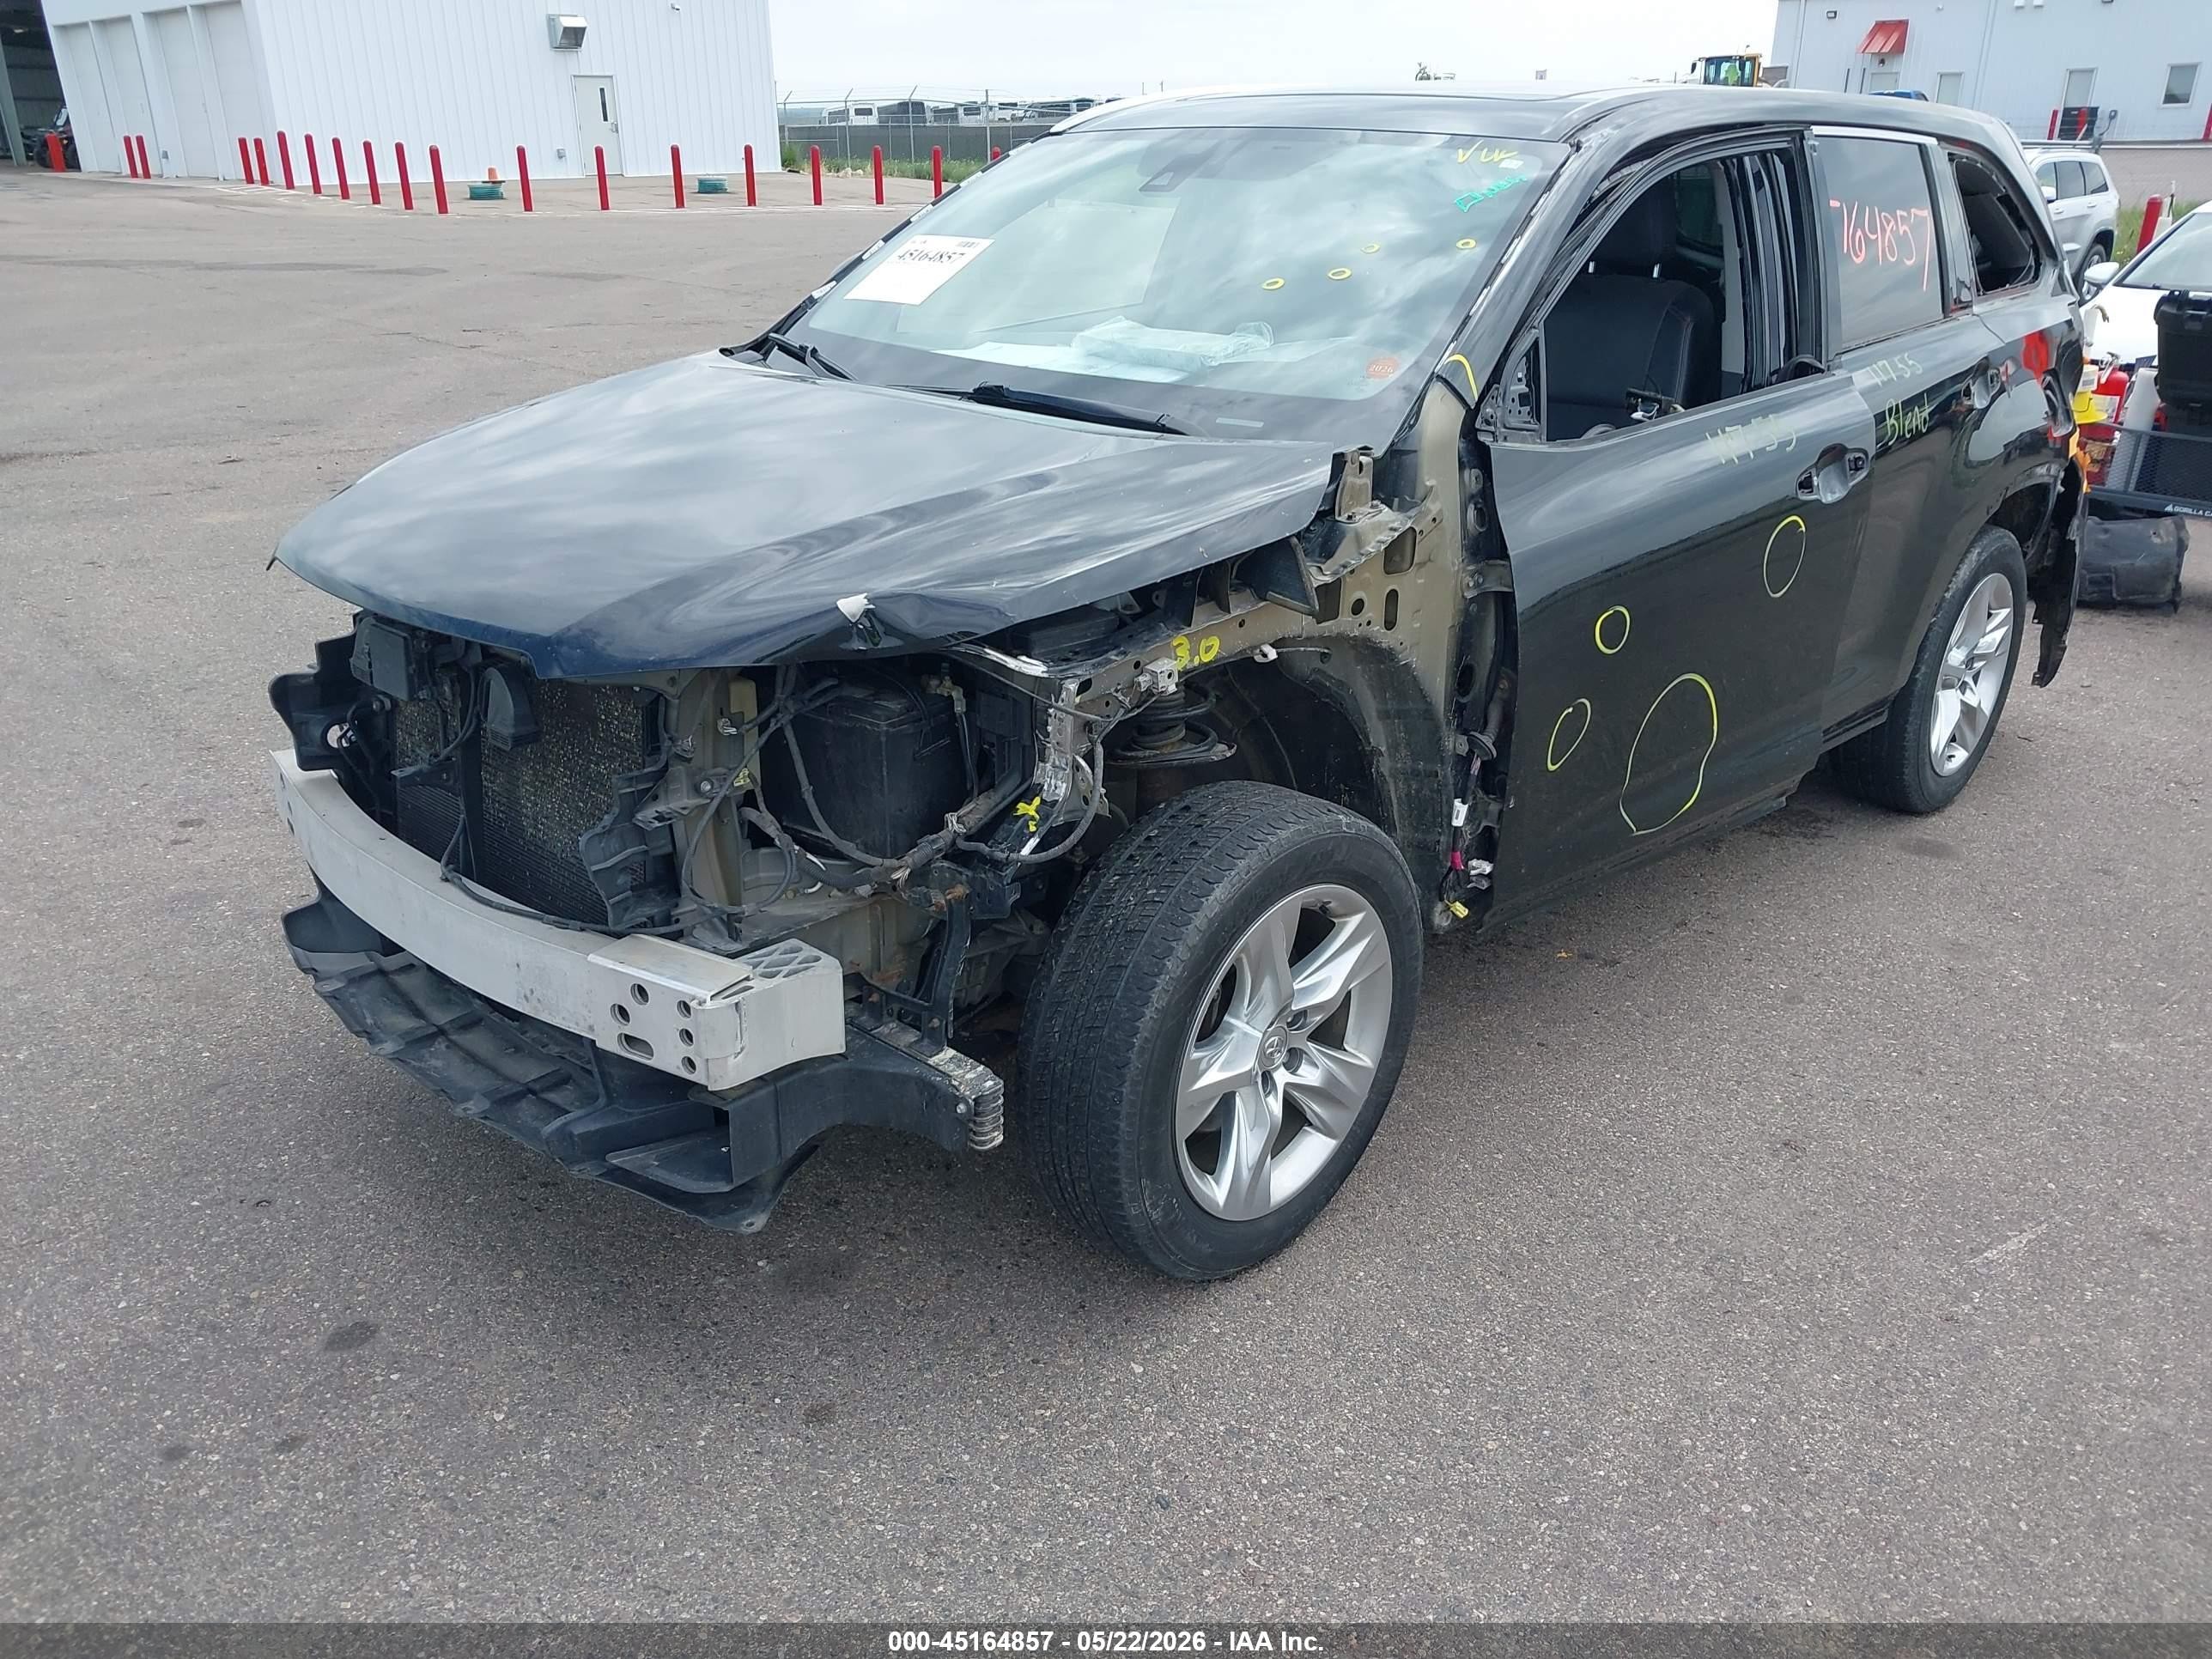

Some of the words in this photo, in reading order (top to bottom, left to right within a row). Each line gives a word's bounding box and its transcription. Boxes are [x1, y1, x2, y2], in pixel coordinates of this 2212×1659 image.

[1369, 364, 1394, 374] 2026
[2173, 507, 2203, 515] GORILLA
[1172, 635, 1220, 672] 3.0
